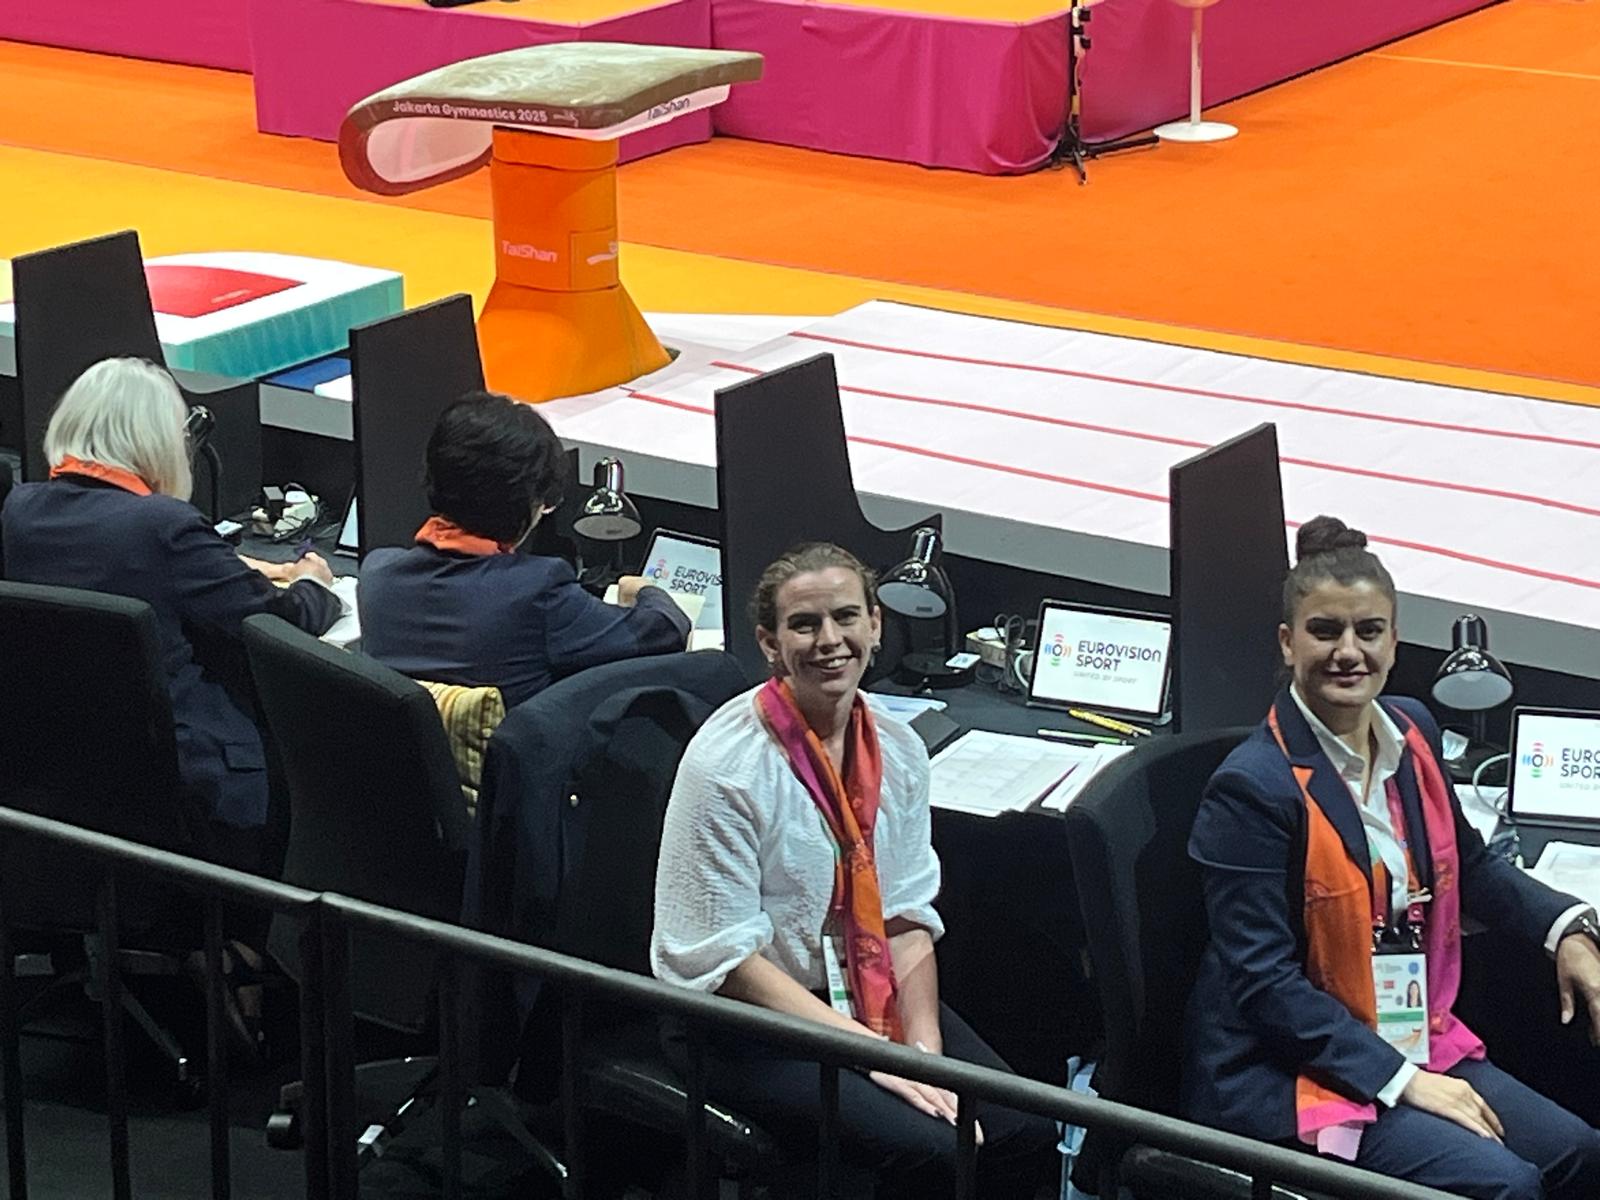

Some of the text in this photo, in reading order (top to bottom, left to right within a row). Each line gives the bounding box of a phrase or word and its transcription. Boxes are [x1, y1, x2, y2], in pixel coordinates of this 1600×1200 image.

[393, 101, 548, 122] Jakarta Gymnastics 2025
[502, 240, 557, 262] TaiShan
[670, 579, 708, 595] SPORT
[1078, 640, 1161, 662] EUROVISION
[1076, 654, 1120, 671] SPORT
